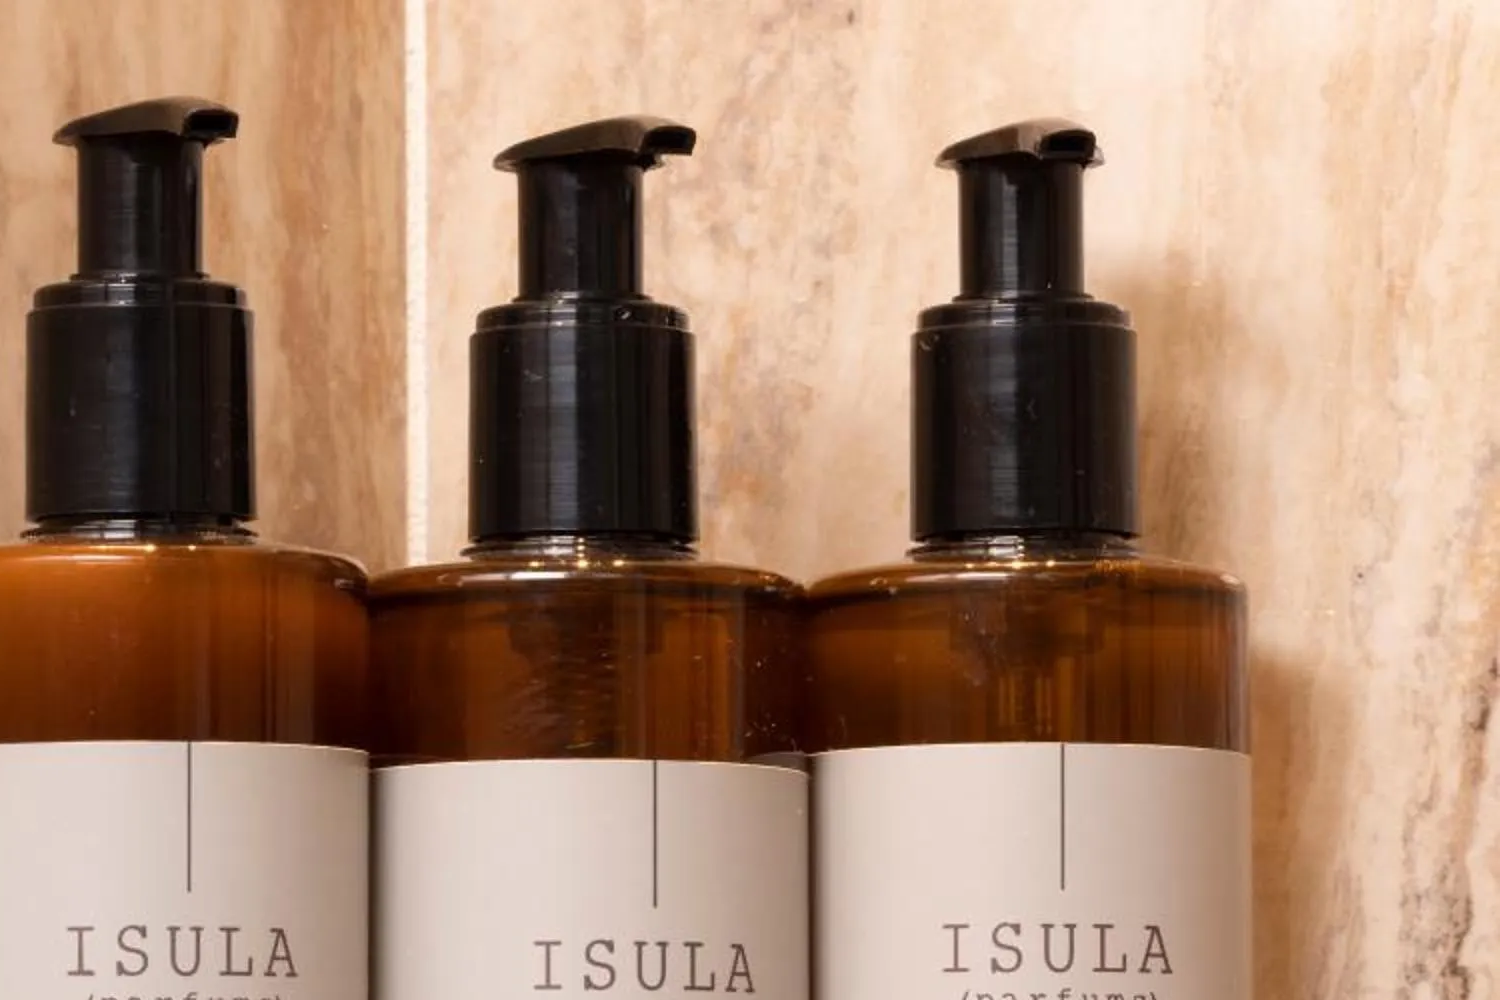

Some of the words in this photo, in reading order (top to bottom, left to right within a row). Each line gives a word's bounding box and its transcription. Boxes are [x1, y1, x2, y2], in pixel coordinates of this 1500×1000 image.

[66, 924, 299, 977] ISULA
[532, 939, 756, 994] ISULA
[942, 922, 1173, 974] ISULA
